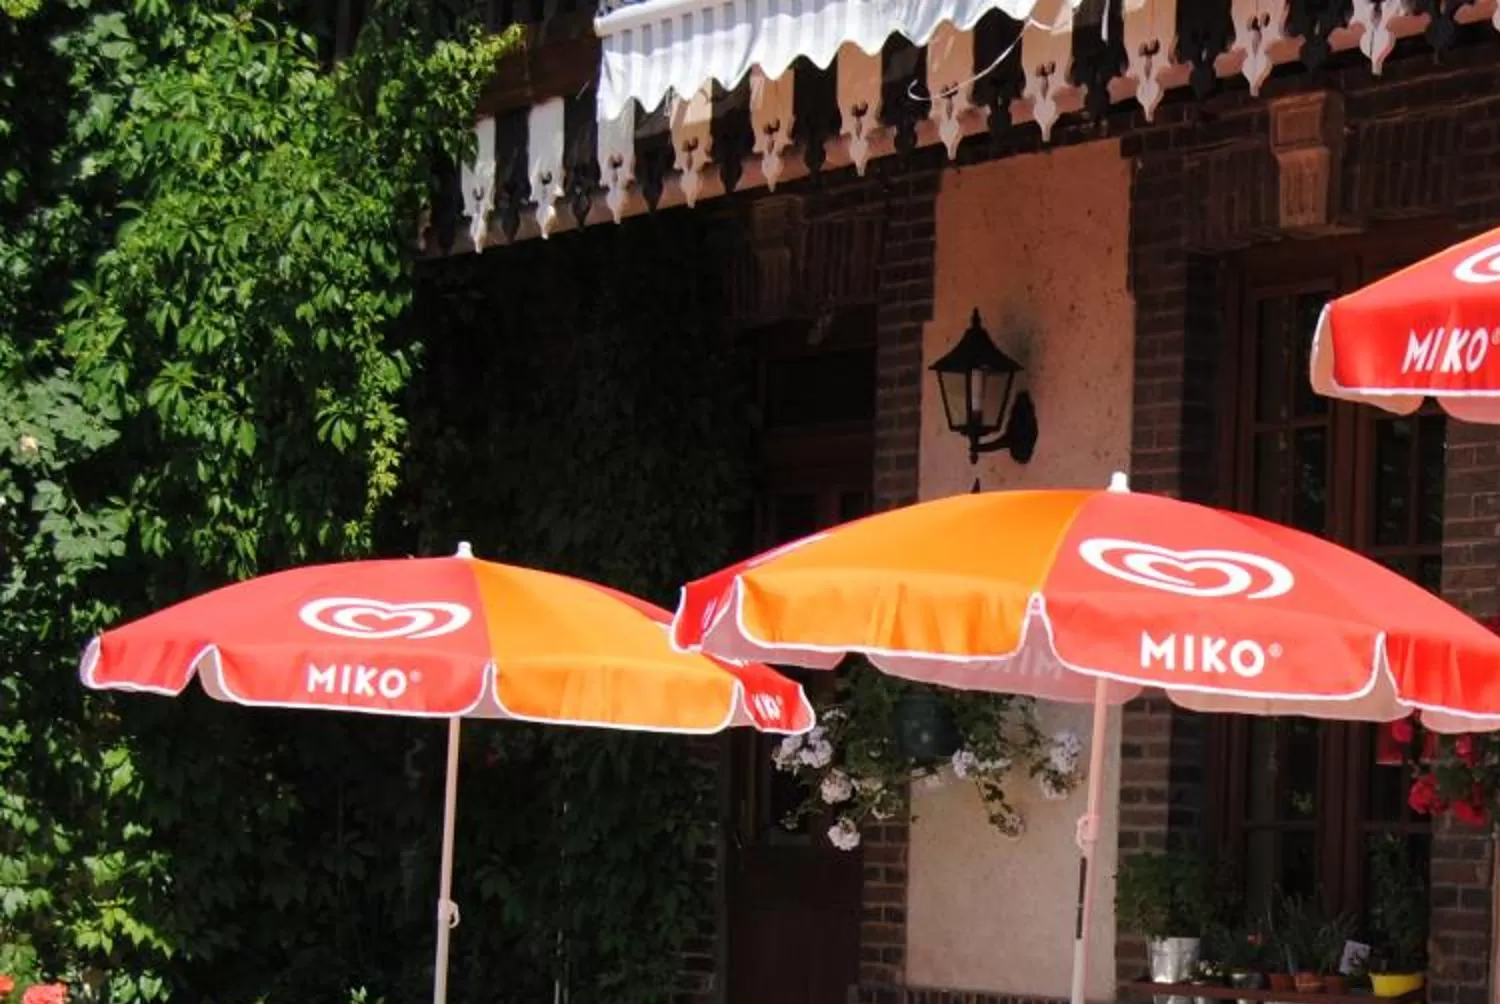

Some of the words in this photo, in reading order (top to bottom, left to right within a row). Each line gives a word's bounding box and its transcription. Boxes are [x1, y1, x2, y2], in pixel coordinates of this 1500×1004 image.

[1401, 327, 1489, 374] MIKO
[1140, 630, 1265, 677] MIKO
[307, 663, 407, 699] MIKO
